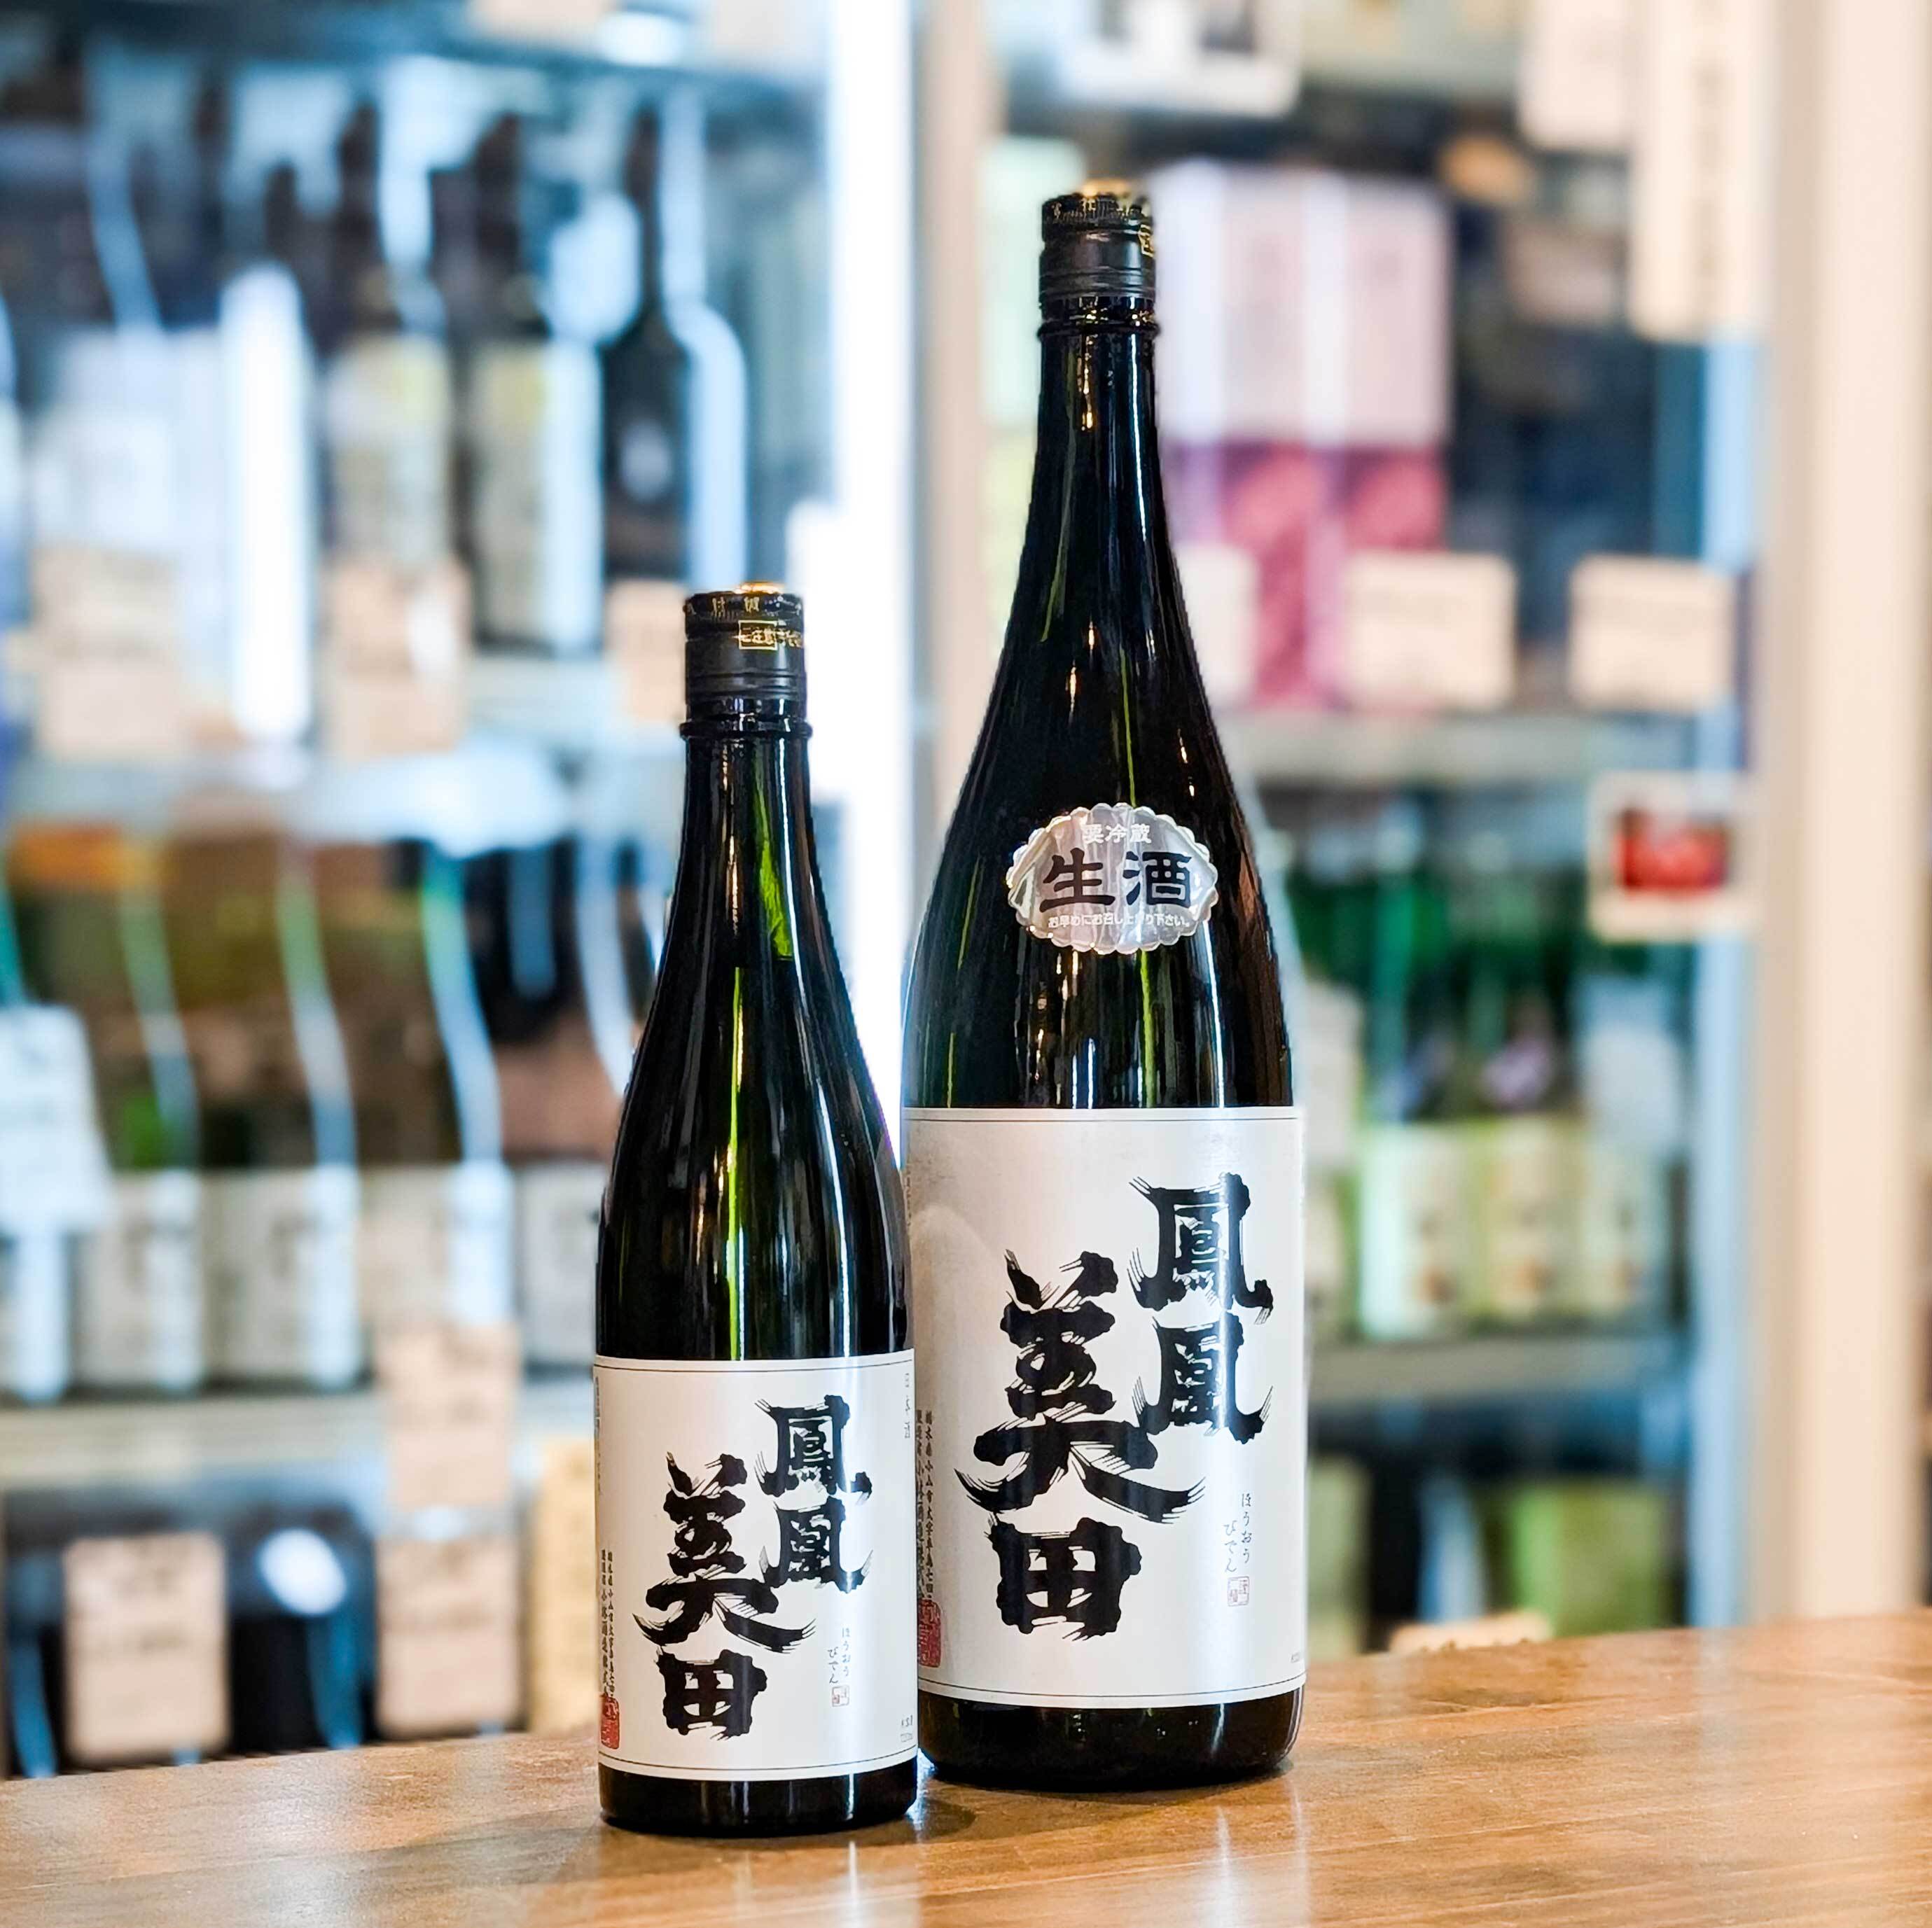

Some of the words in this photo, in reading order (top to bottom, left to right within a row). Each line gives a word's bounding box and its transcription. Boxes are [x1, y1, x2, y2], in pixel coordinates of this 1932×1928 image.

[1081, 823, 1152, 844] 要冷蔵
[1040, 847, 1192, 913] 生酒
[1128, 1173, 1274, 1445] 鳳凰
[954, 1249, 1206, 1642] 美田
[754, 1395, 874, 1595] 鳳凰
[1242, 1493, 1253, 1564] ほうおう
[1223, 1521, 1238, 1573] びてん
[633, 1451, 816, 1742] 美田
[827, 1646, 839, 1684] びてん
[841, 1627, 851, 1677] ほうおう
